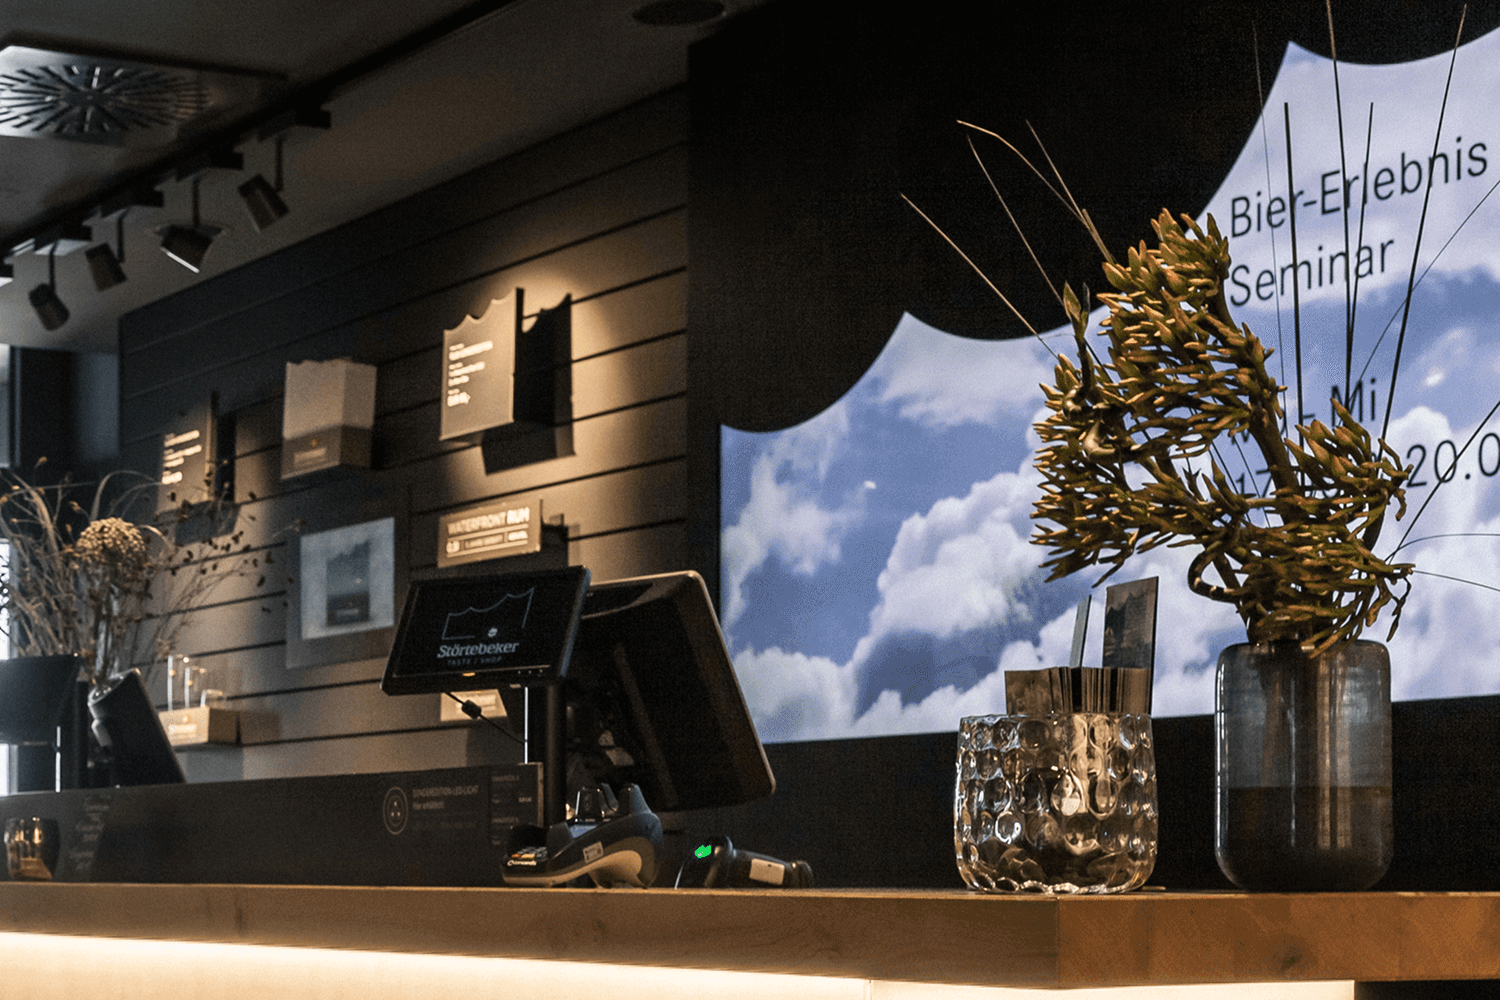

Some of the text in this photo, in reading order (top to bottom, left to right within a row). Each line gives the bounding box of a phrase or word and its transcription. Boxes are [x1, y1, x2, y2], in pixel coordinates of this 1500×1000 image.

[1231, 135, 1488, 239] Bier-Erlebnis
[1230, 239, 1395, 307] Seminar
[437, 642, 520, 659] Störtebeker
